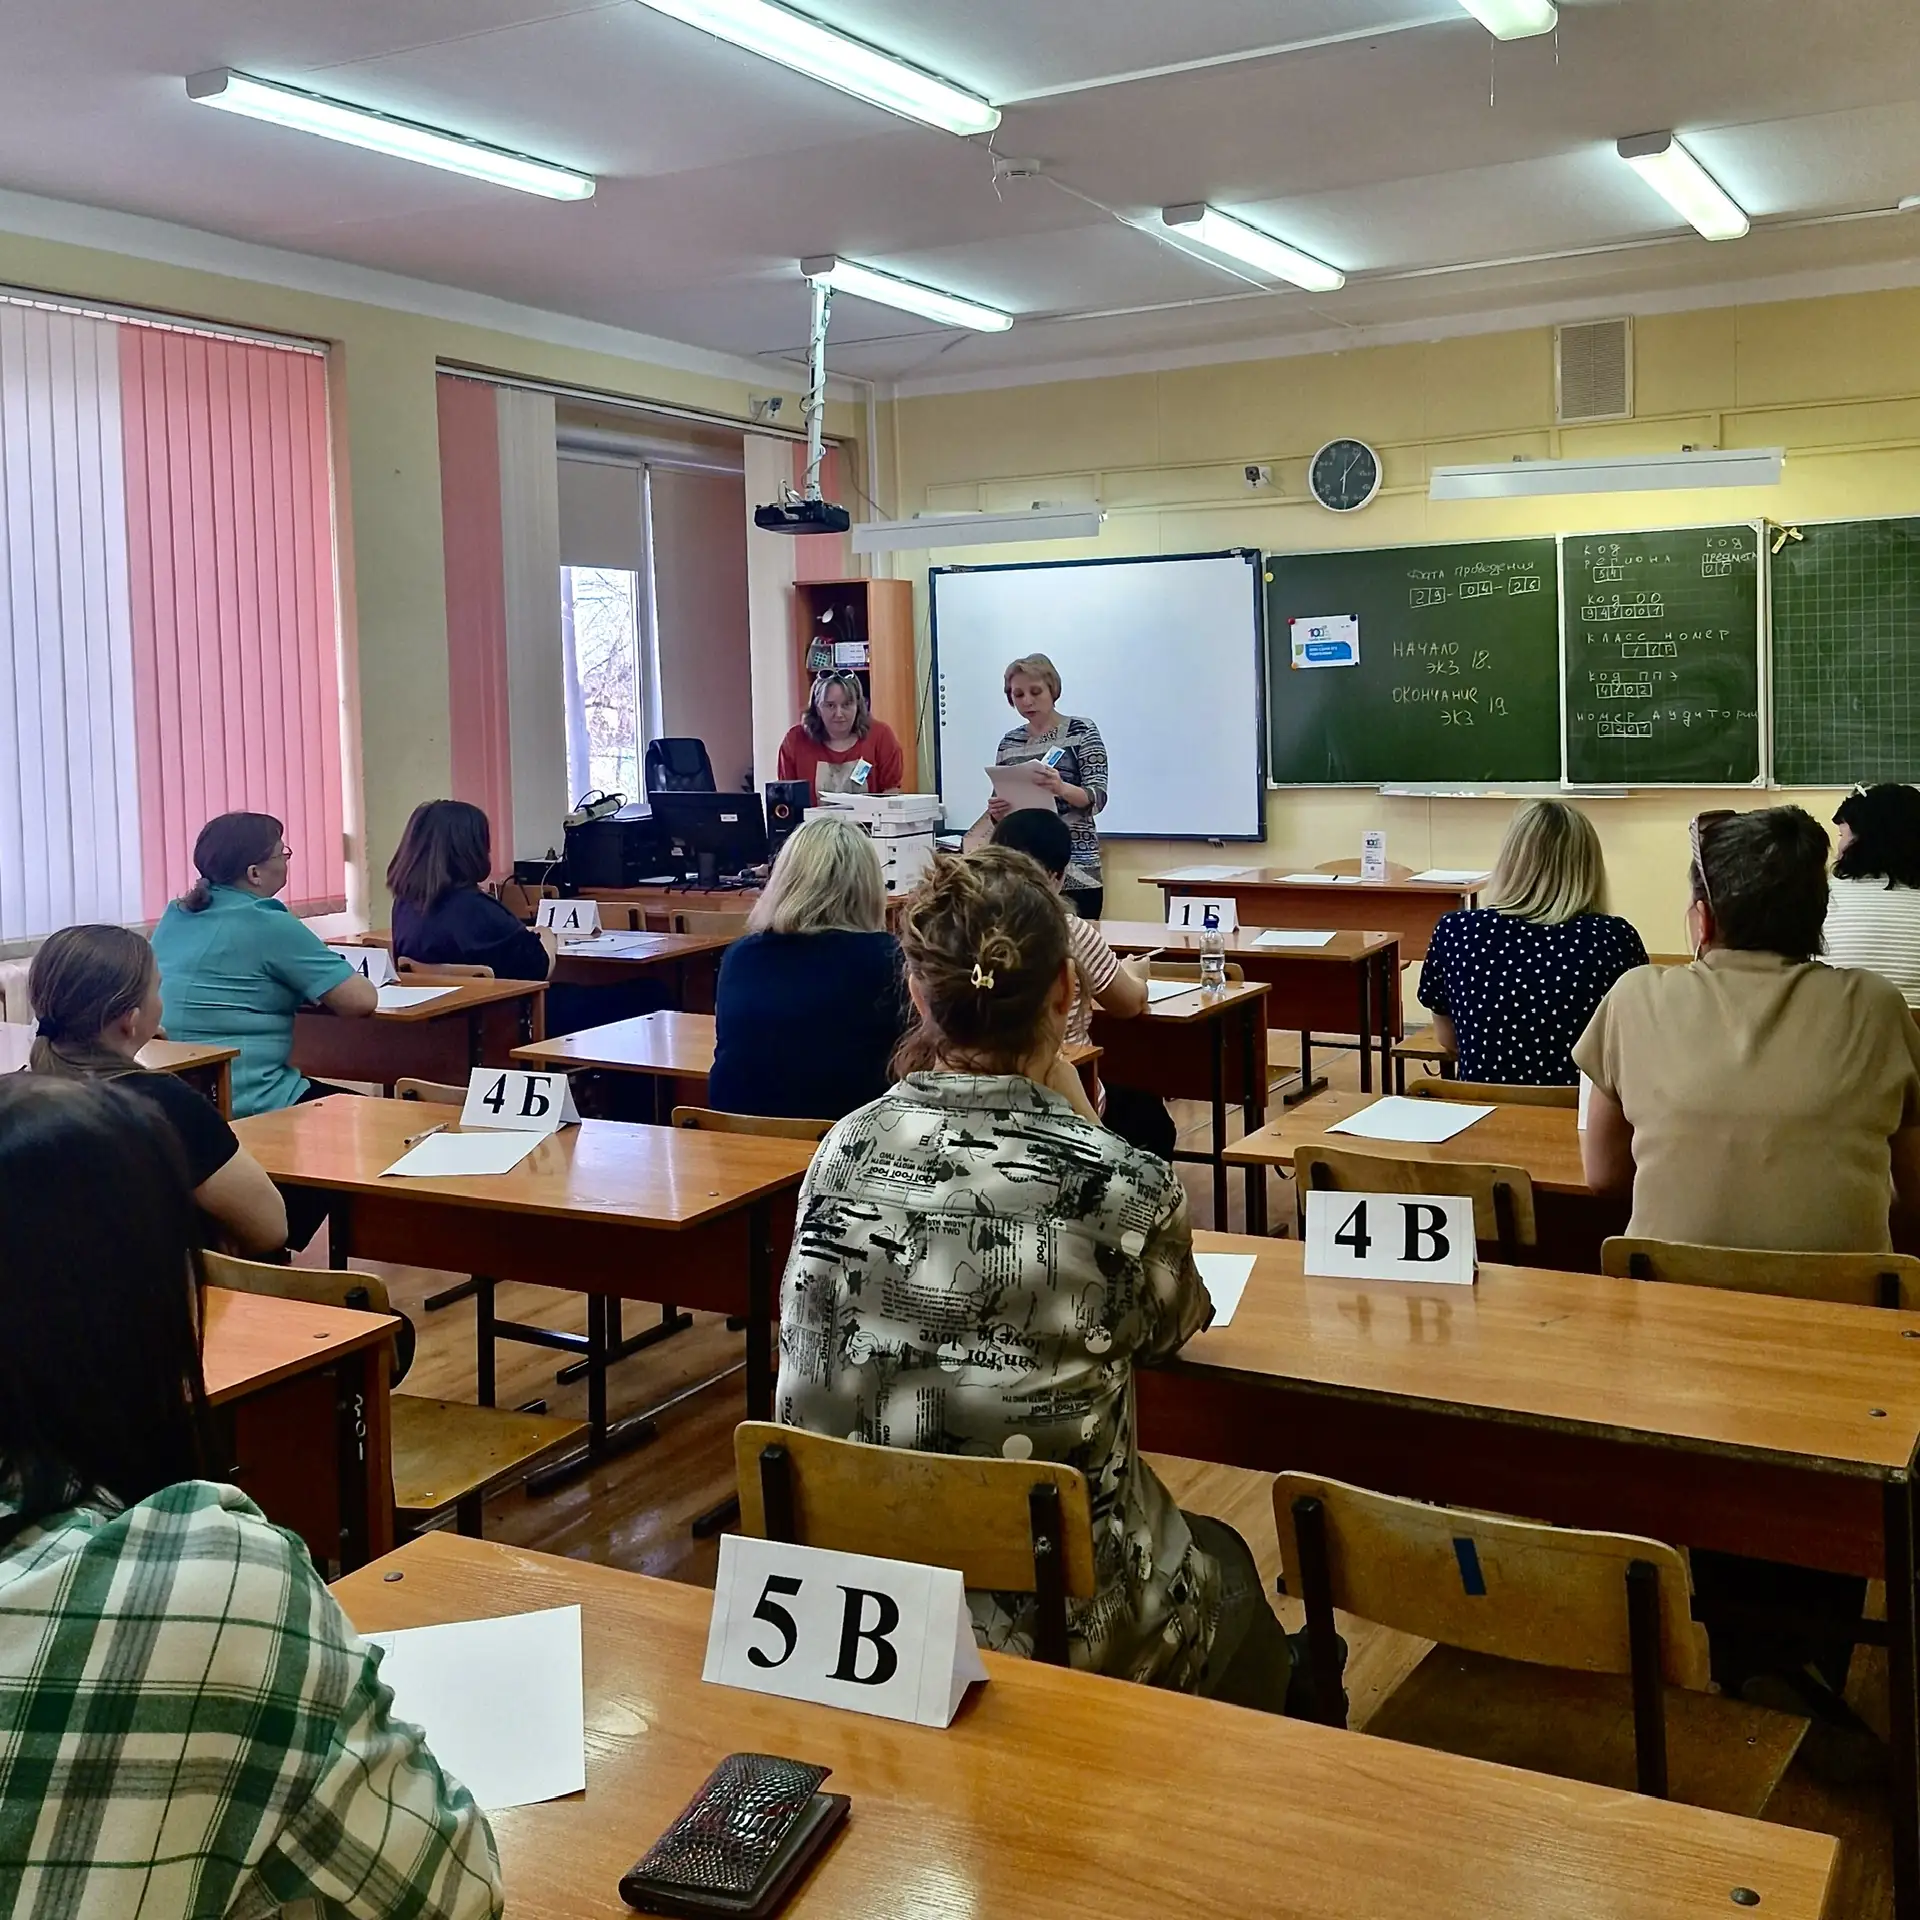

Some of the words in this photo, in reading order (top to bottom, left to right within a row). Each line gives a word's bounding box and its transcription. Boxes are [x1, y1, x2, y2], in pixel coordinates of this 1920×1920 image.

[1393, 641, 1459, 657] НАЧАЛО
[547, 906, 556, 928] 1
[562, 907, 580, 928] А
[1181, 903, 1191, 926] 1
[1201, 904, 1222, 928] Б
[483, 1073, 507, 1114] 4
[516, 1075, 552, 1117] Б
[1334, 1200, 1372, 1259] 4
[1397, 1203, 1450, 1262] В
[747, 1574, 803, 1669] 5
[825, 1584, 900, 1686] В
